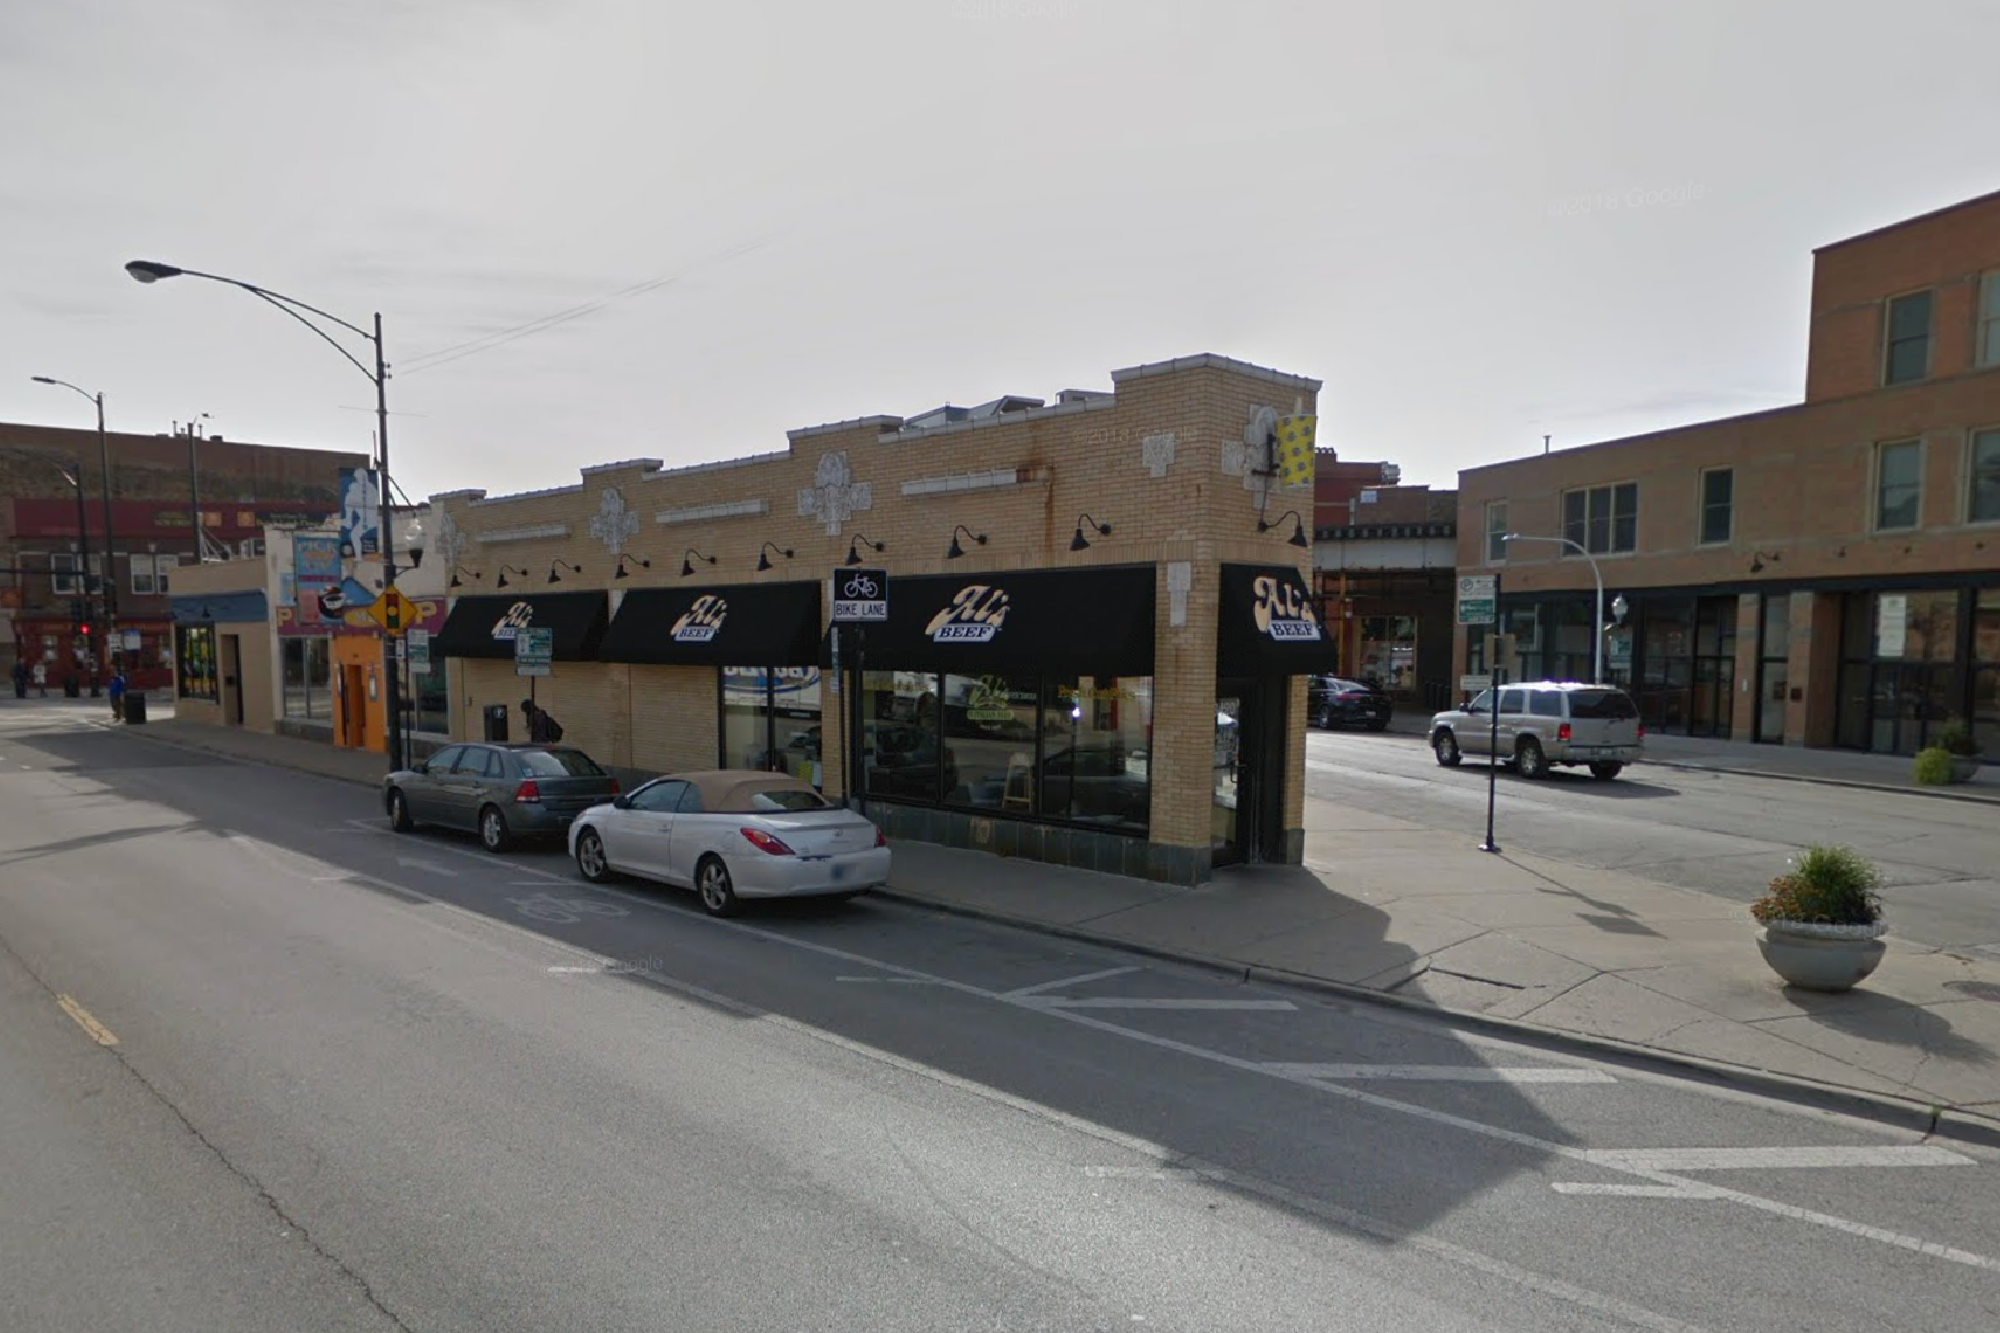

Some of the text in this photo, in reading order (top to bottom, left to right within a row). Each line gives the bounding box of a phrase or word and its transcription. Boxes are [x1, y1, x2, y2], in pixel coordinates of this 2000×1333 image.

[836, 602, 885, 616] BIKE LANE
[925, 585, 1010, 635] Al's
[1253, 576, 1316, 632] Al's
[670, 594, 728, 636] Al's
[678, 627, 714, 638] BEEF
[938, 625, 992, 639] BEEF
[1272, 623, 1313, 636] BEEF
